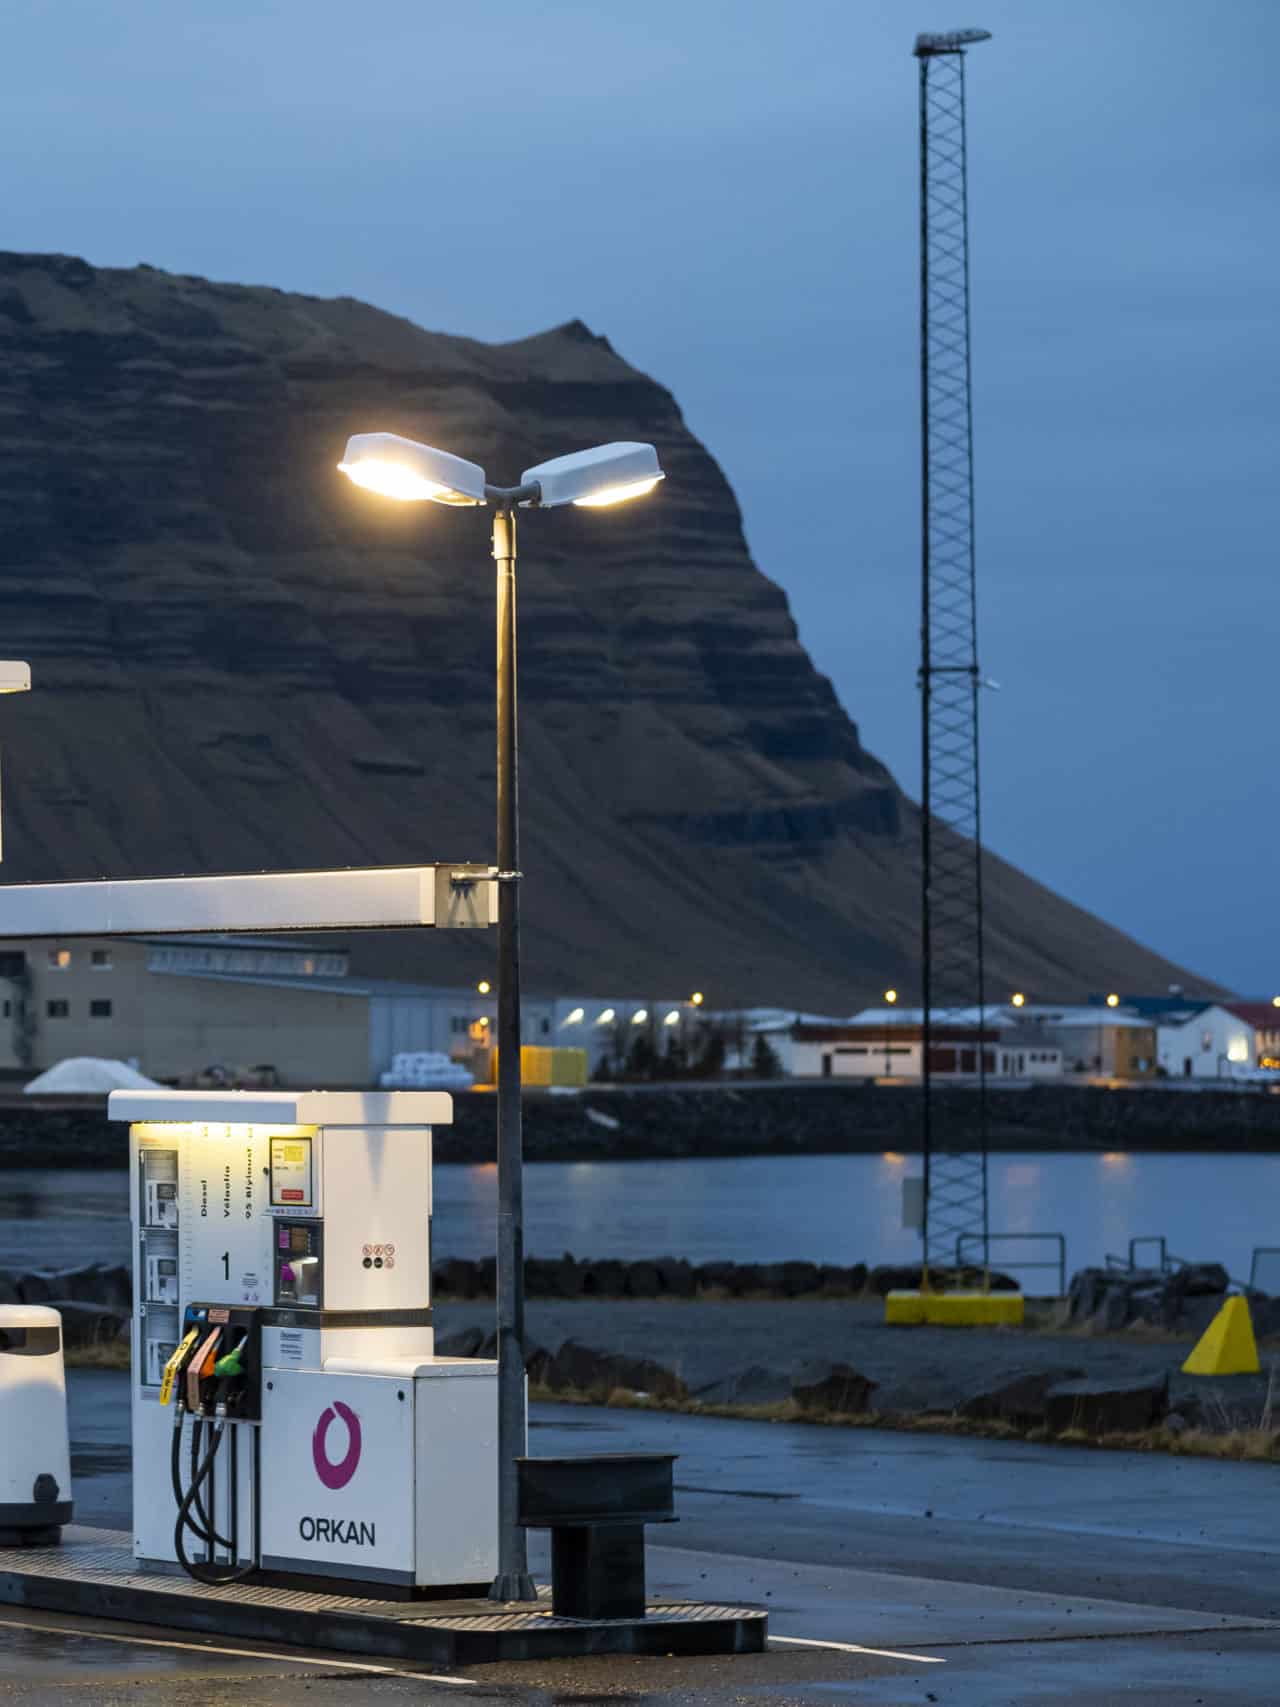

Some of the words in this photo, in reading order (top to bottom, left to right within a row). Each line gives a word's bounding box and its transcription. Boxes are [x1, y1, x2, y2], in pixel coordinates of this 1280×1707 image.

[200, 1180, 208, 1217] Diesel
[221, 1251, 229, 1281] 1
[299, 1516, 376, 1547] ORKAN
